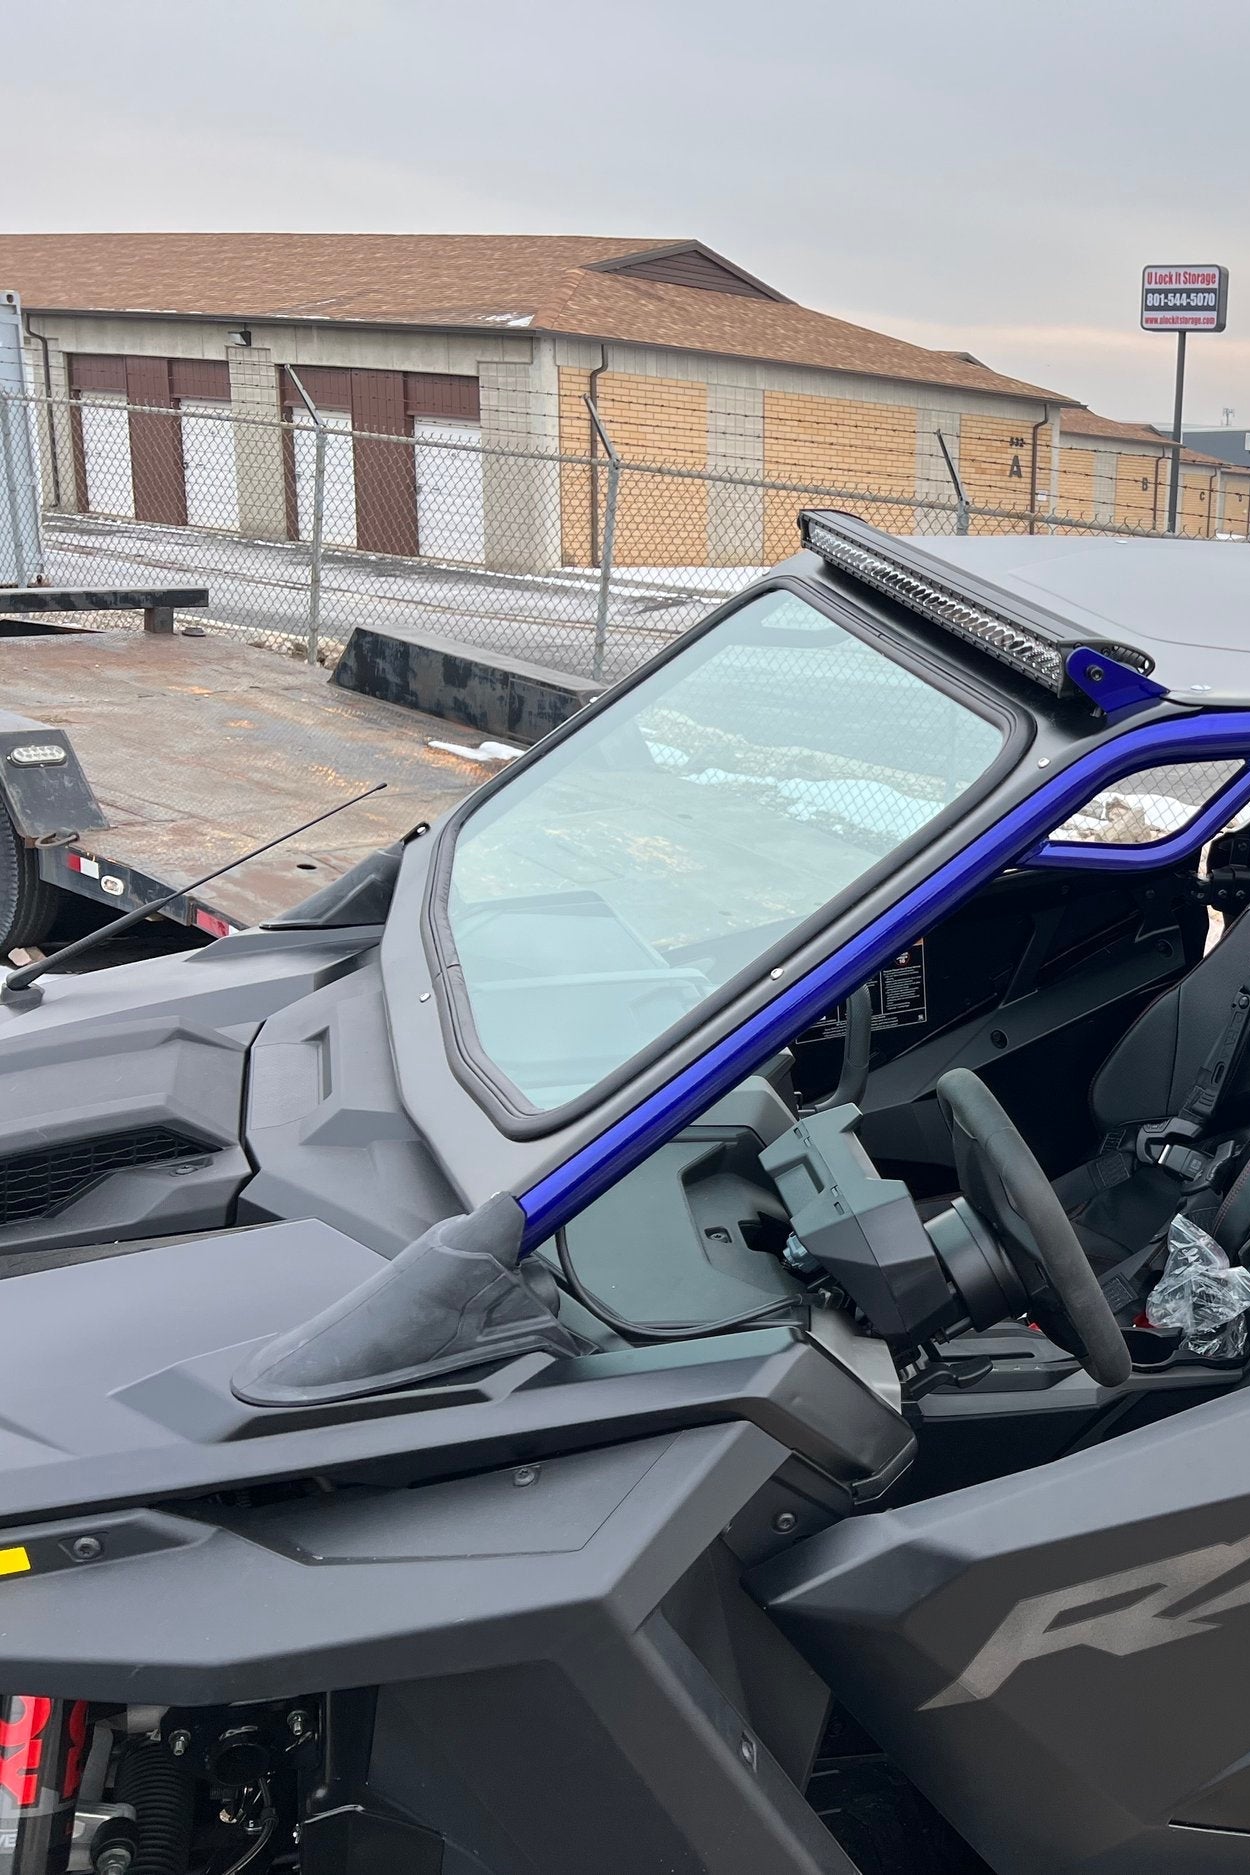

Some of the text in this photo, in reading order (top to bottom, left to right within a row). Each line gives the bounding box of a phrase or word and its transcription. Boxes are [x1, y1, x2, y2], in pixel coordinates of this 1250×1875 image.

[1147, 271, 1217, 286] U Lock It Storage
[1146, 293, 1216, 306] 801-544-5070
[1008, 455, 1023, 478] A
